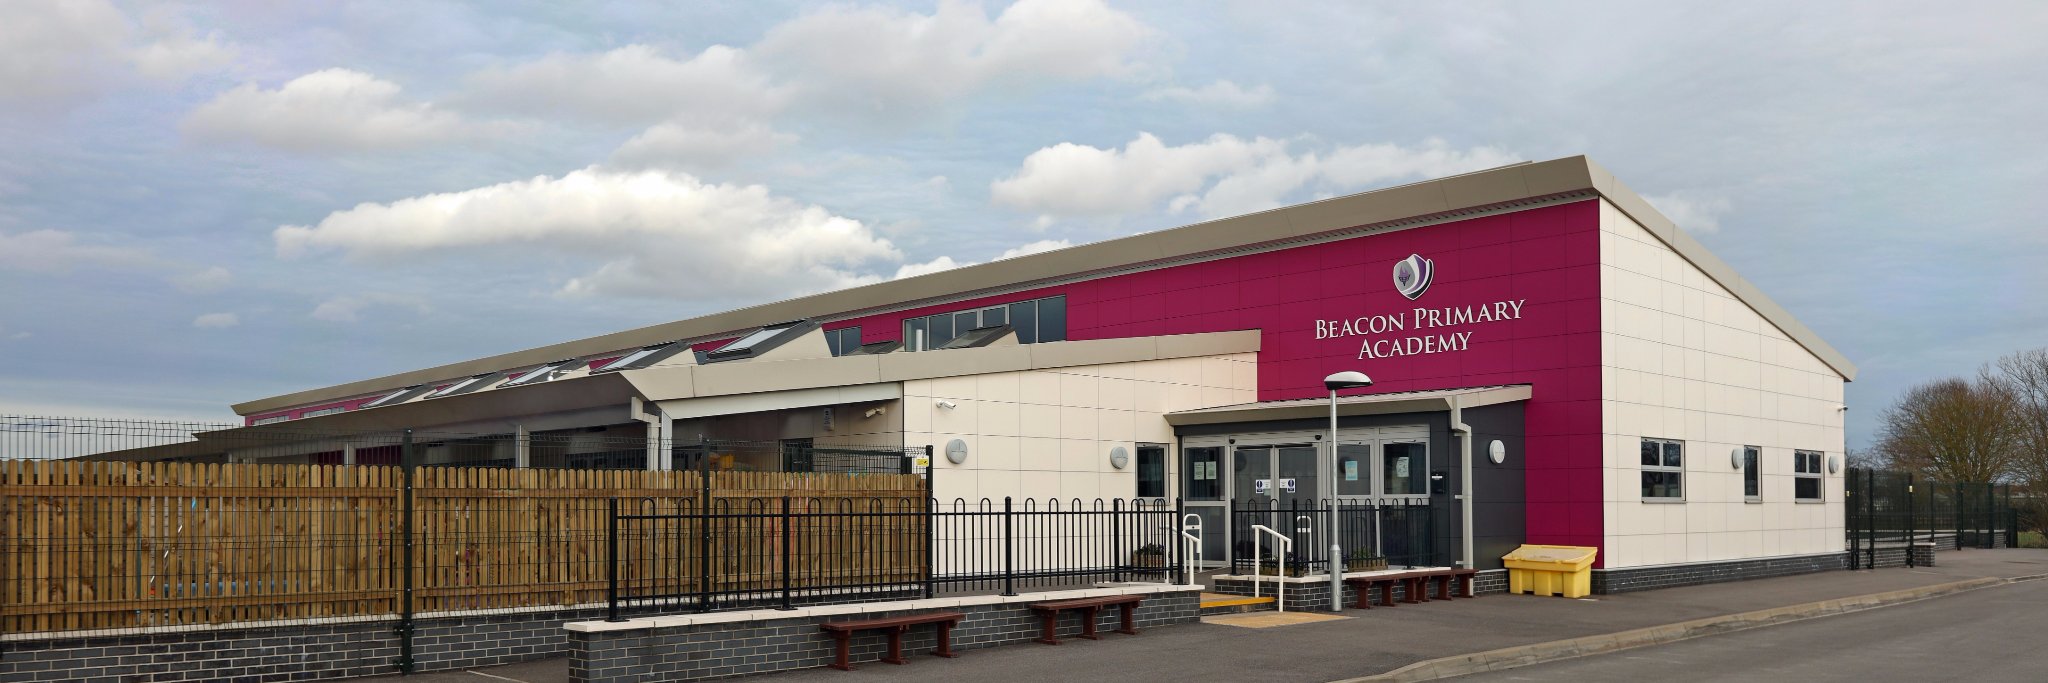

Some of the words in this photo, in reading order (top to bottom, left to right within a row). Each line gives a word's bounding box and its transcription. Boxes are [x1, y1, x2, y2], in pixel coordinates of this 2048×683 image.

[1314, 312, 1405, 340] BEACON
[1413, 299, 1526, 330] PRIMARY
[1357, 331, 1473, 360] ACADEMY
